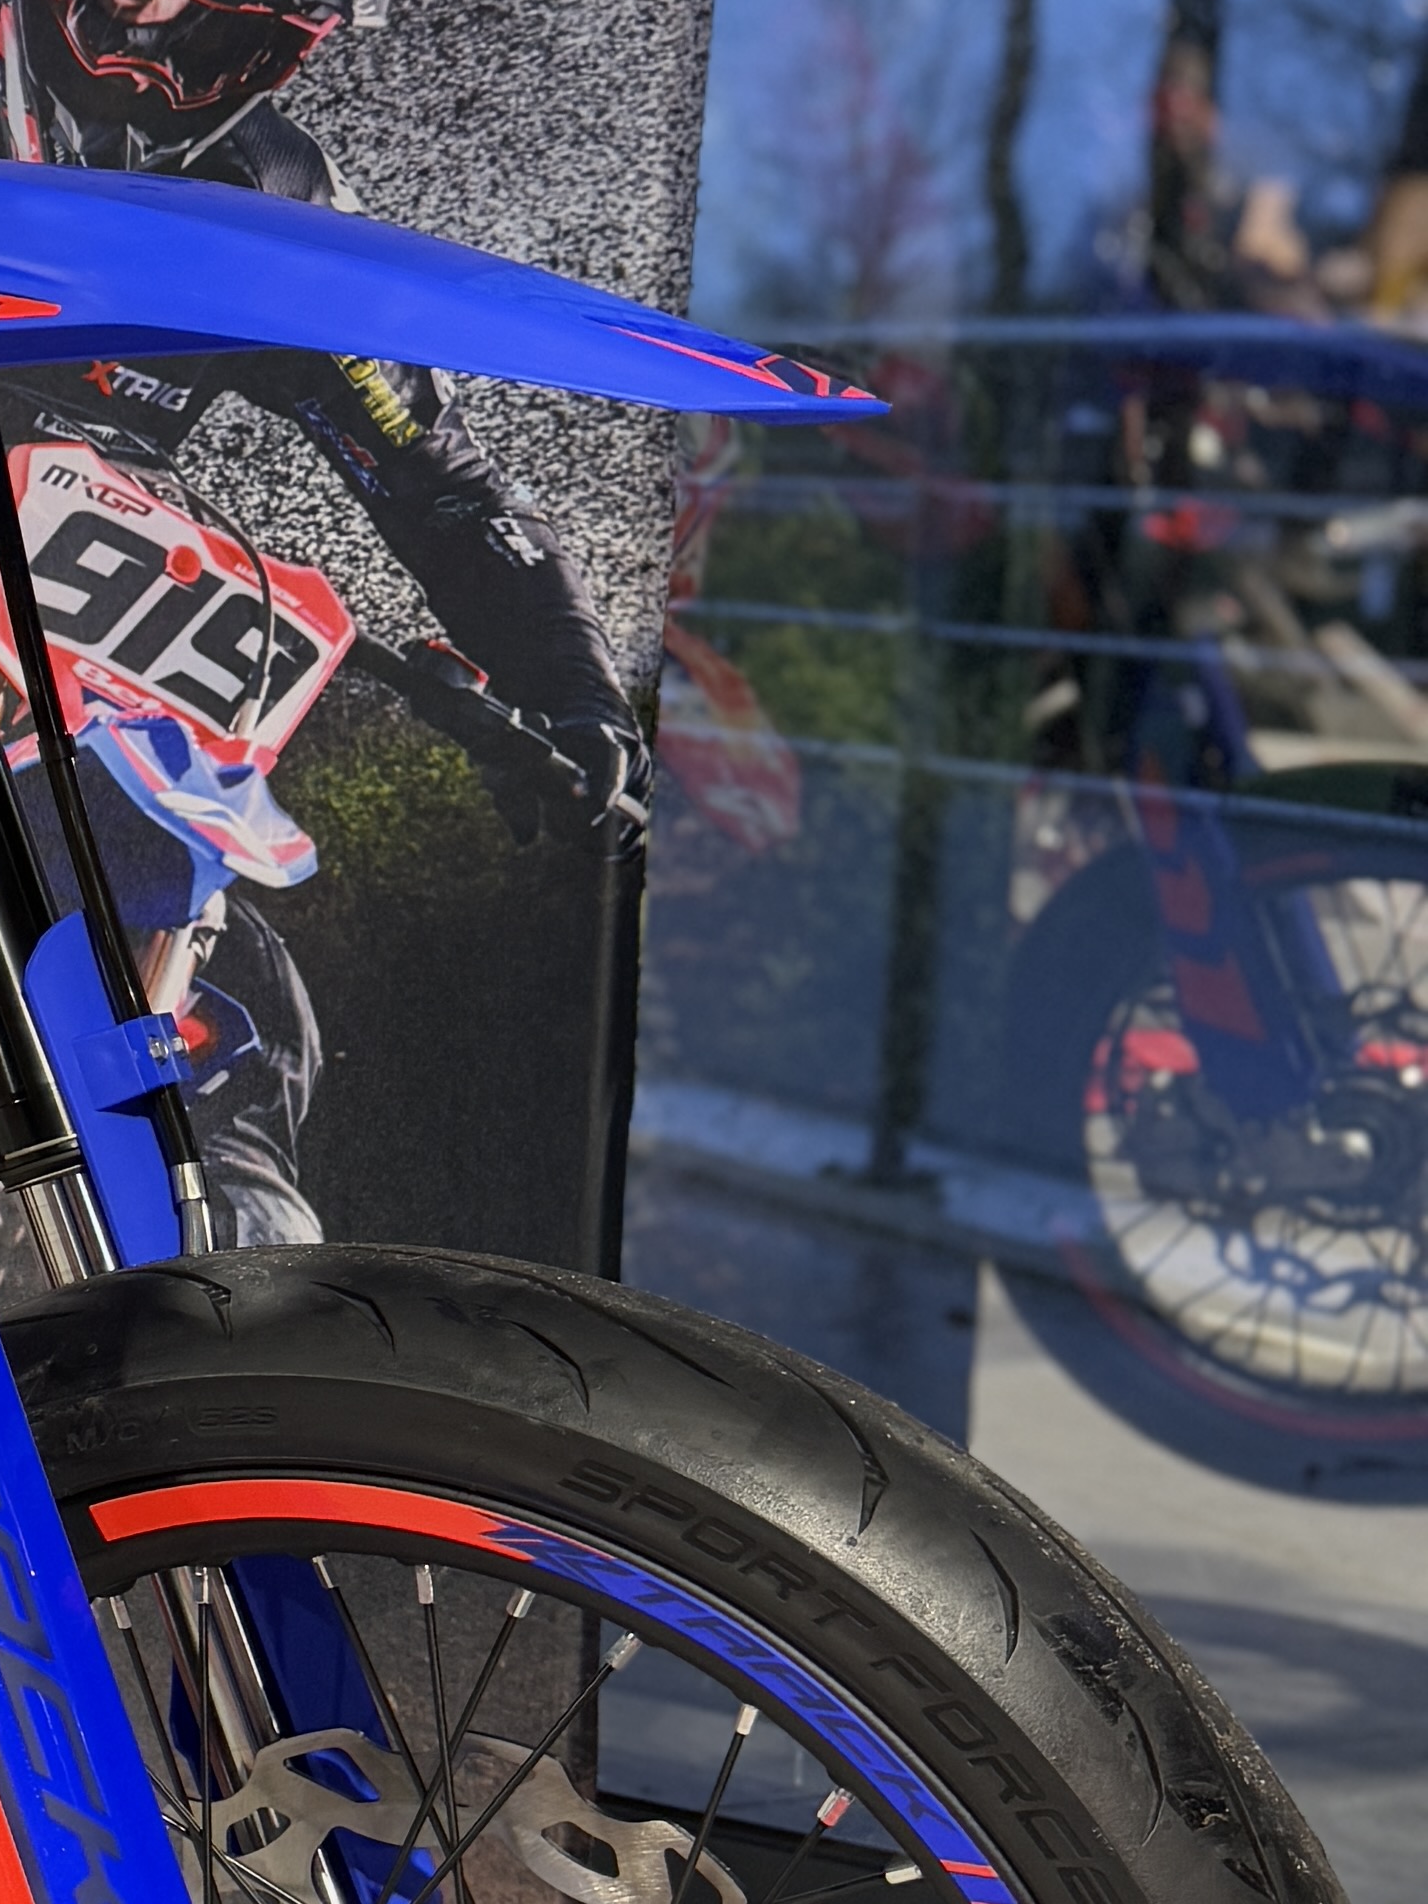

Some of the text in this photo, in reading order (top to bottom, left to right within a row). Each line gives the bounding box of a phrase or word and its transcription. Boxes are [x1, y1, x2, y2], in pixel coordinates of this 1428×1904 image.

[80, 359, 193, 412] XTRIG
[40, 463, 154, 517] MXGP
[29, 509, 319, 732] 919
[557, 1458, 879, 1633] SPORT
